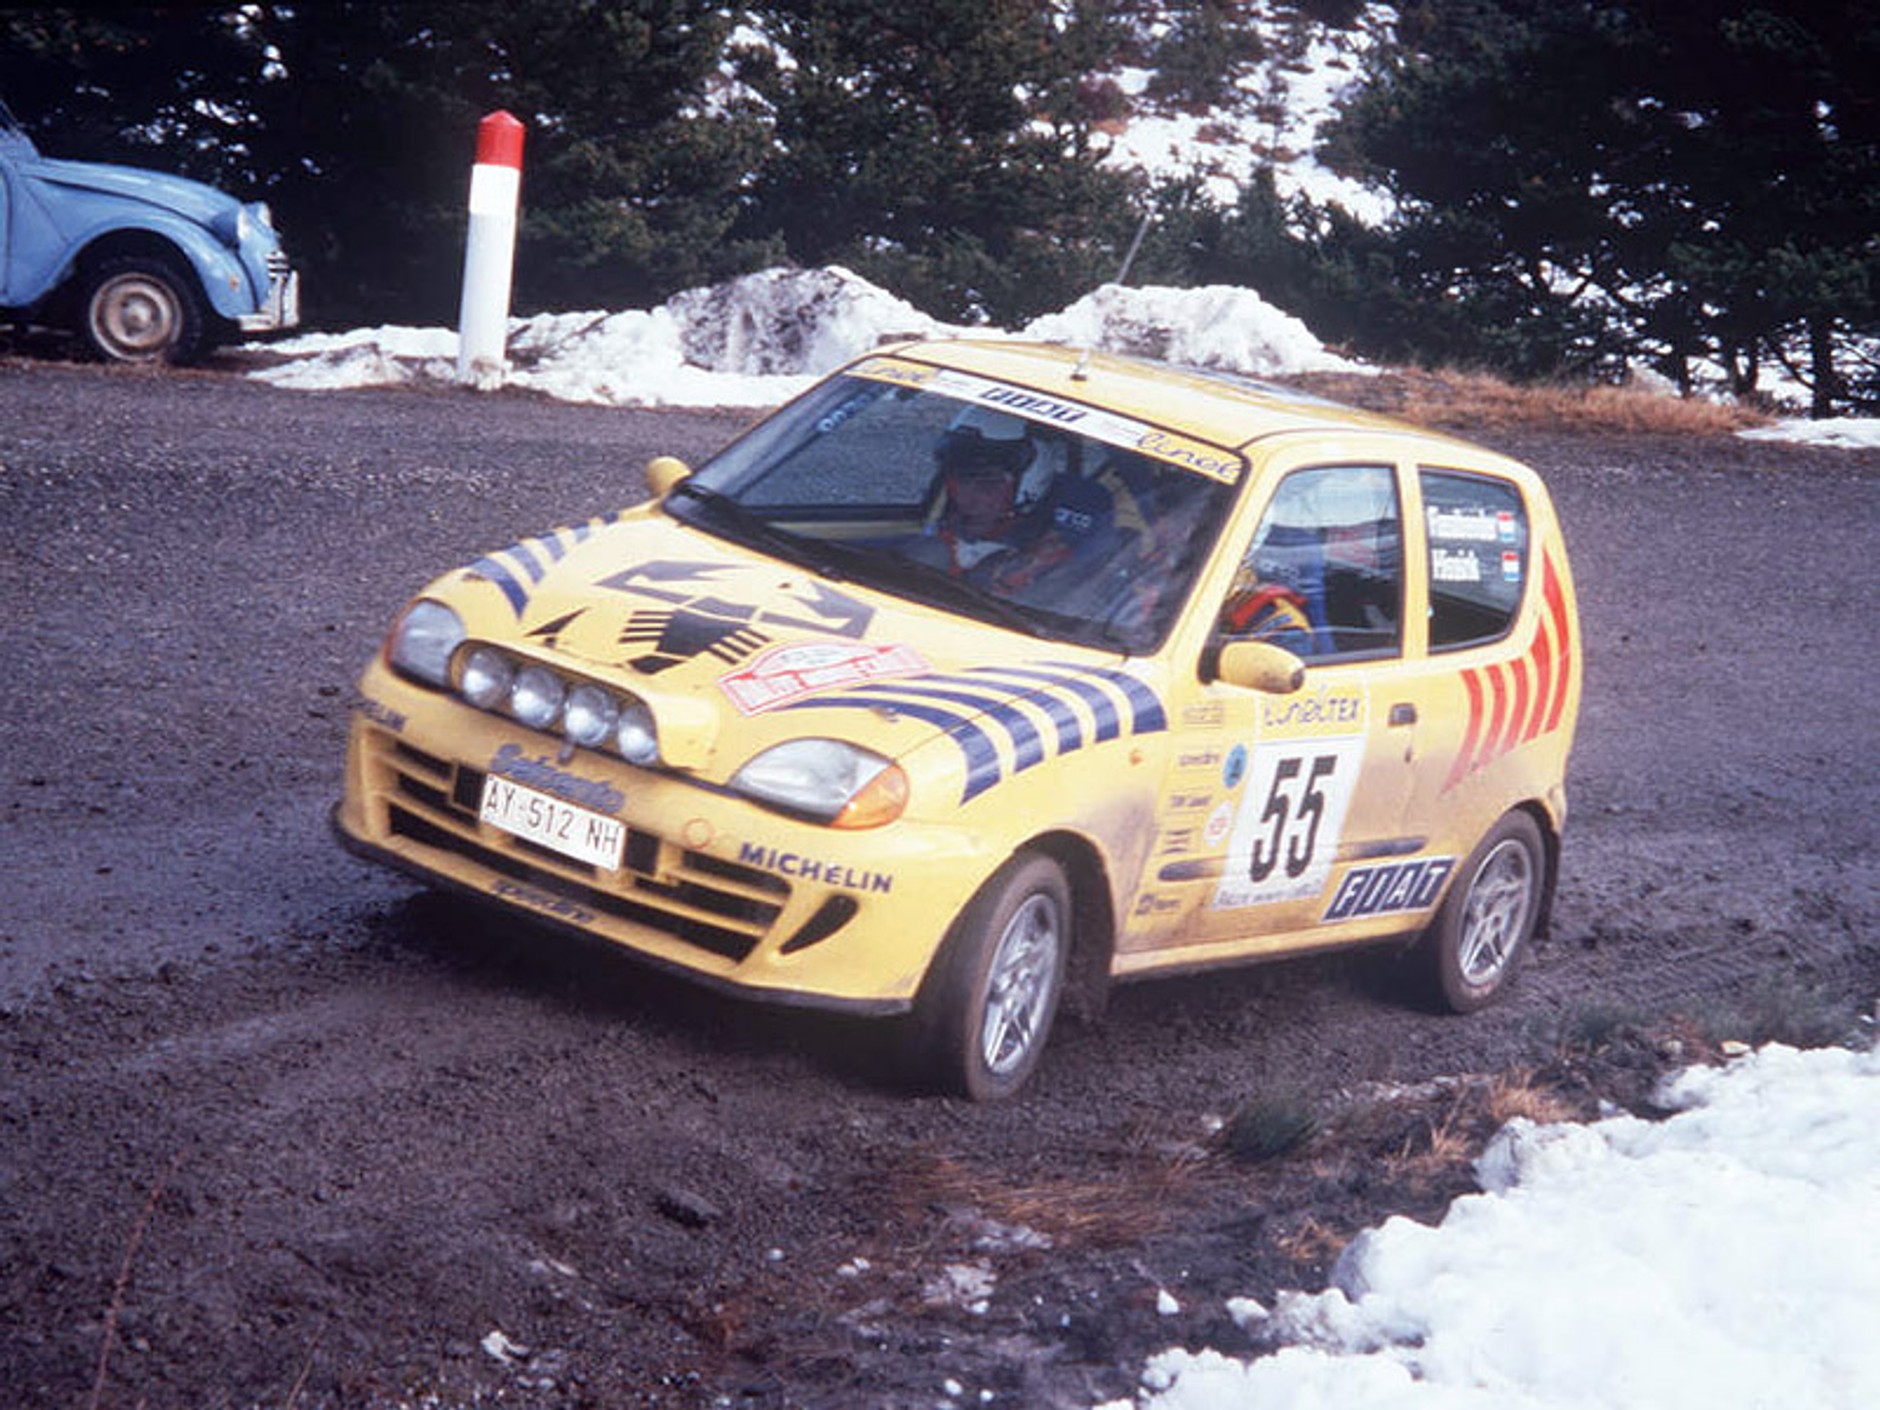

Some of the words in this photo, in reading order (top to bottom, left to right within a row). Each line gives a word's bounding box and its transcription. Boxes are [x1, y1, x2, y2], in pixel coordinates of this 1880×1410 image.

[485, 780, 517, 818] AY
[527, 796, 575, 841] 512
[585, 817, 620, 856] NH
[1249, 754, 1339, 884] 55
[738, 842, 893, 893] MICHELIN
[1331, 863, 1450, 915] FIAT
